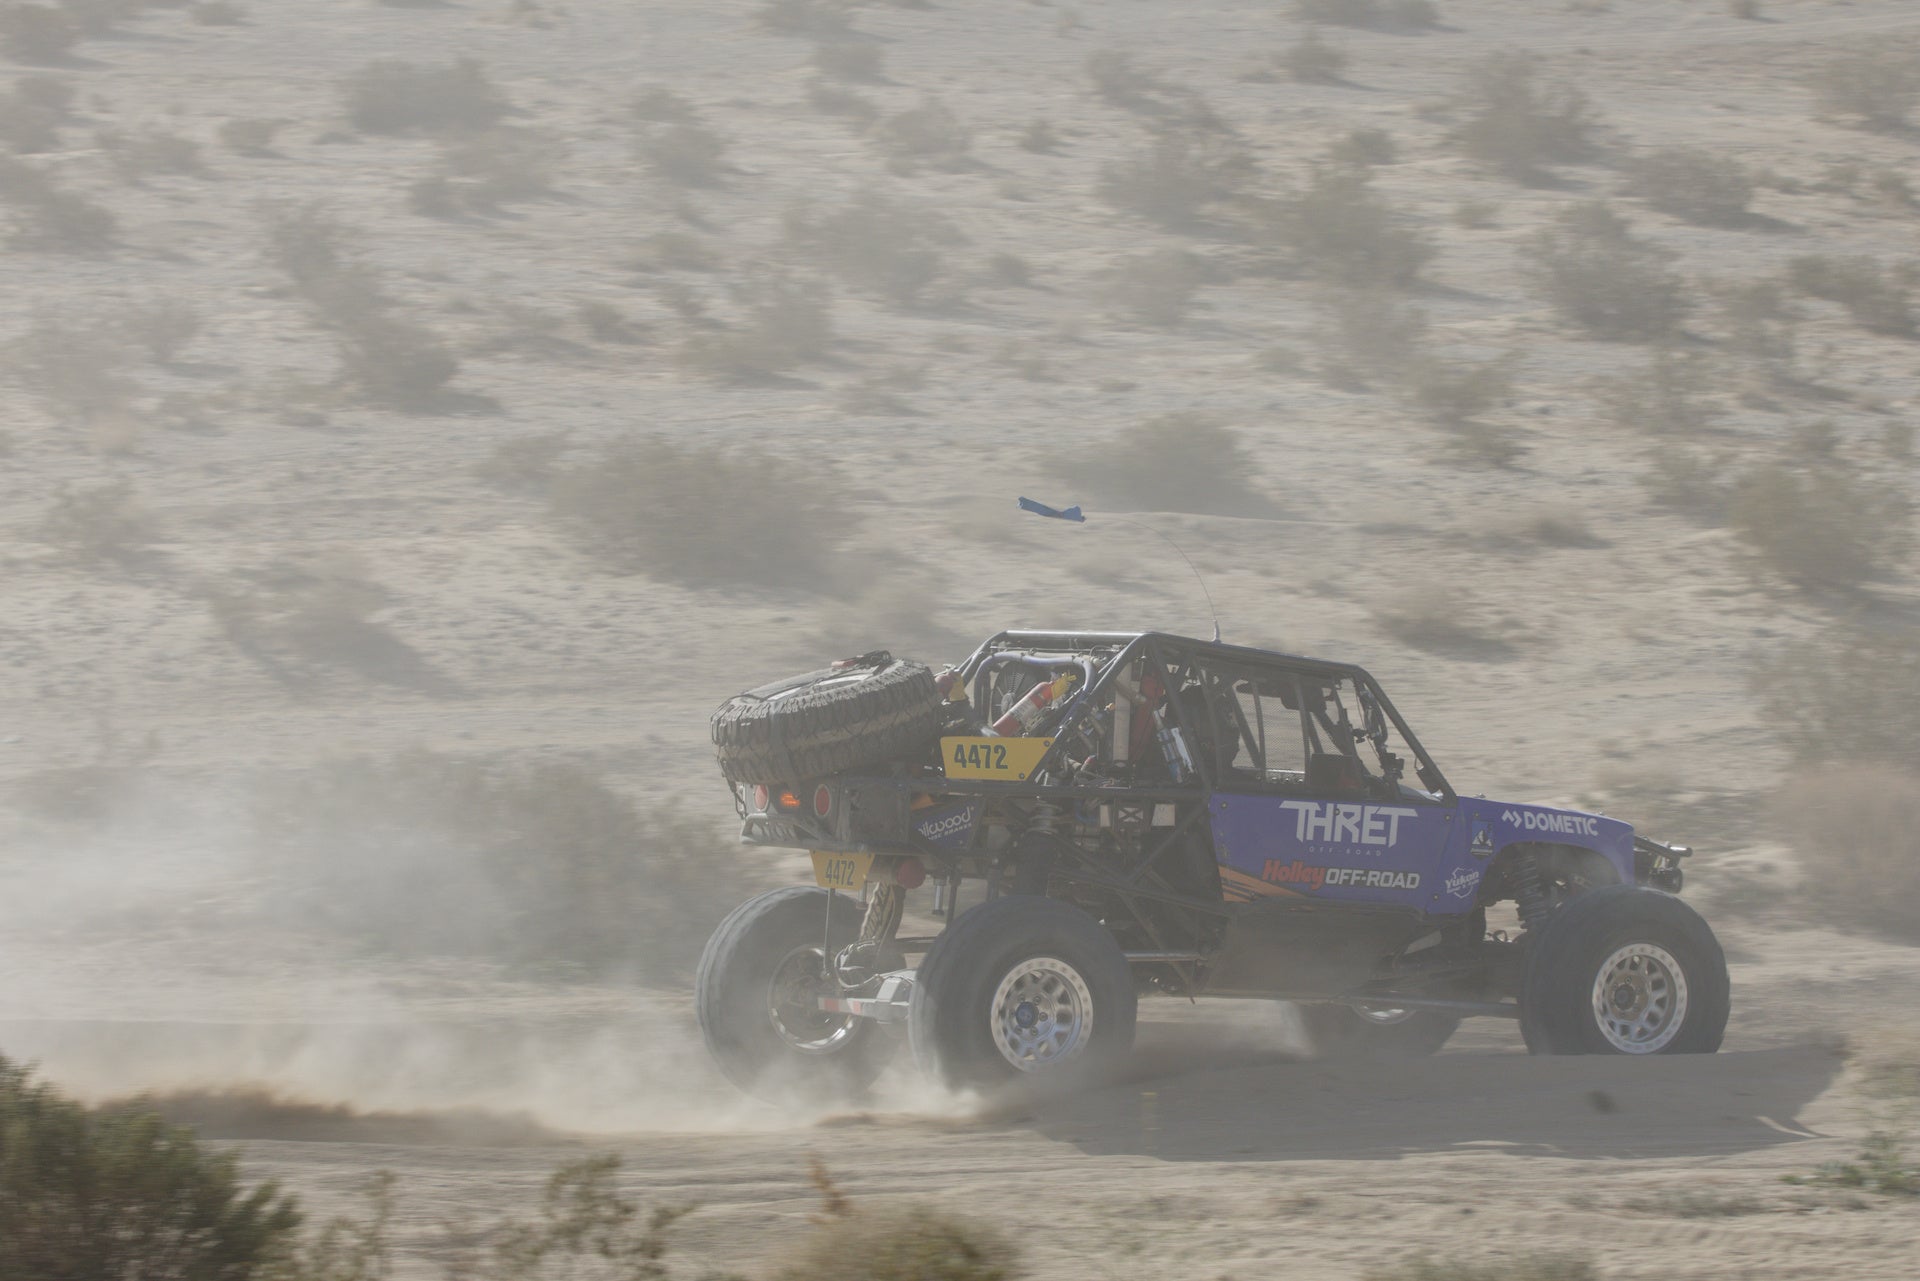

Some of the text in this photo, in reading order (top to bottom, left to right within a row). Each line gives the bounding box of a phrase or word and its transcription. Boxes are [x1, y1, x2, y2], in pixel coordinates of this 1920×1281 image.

[954, 744, 1009, 770] 4472
[1279, 800, 1418, 848] THRET
[1524, 811, 1599, 837] DOMETIC
[825, 859, 856, 886] 4472
[1262, 859, 1326, 891] Holley
[1325, 868, 1420, 889] OFF-ROAD
[1445, 871, 1480, 889] Yukon
